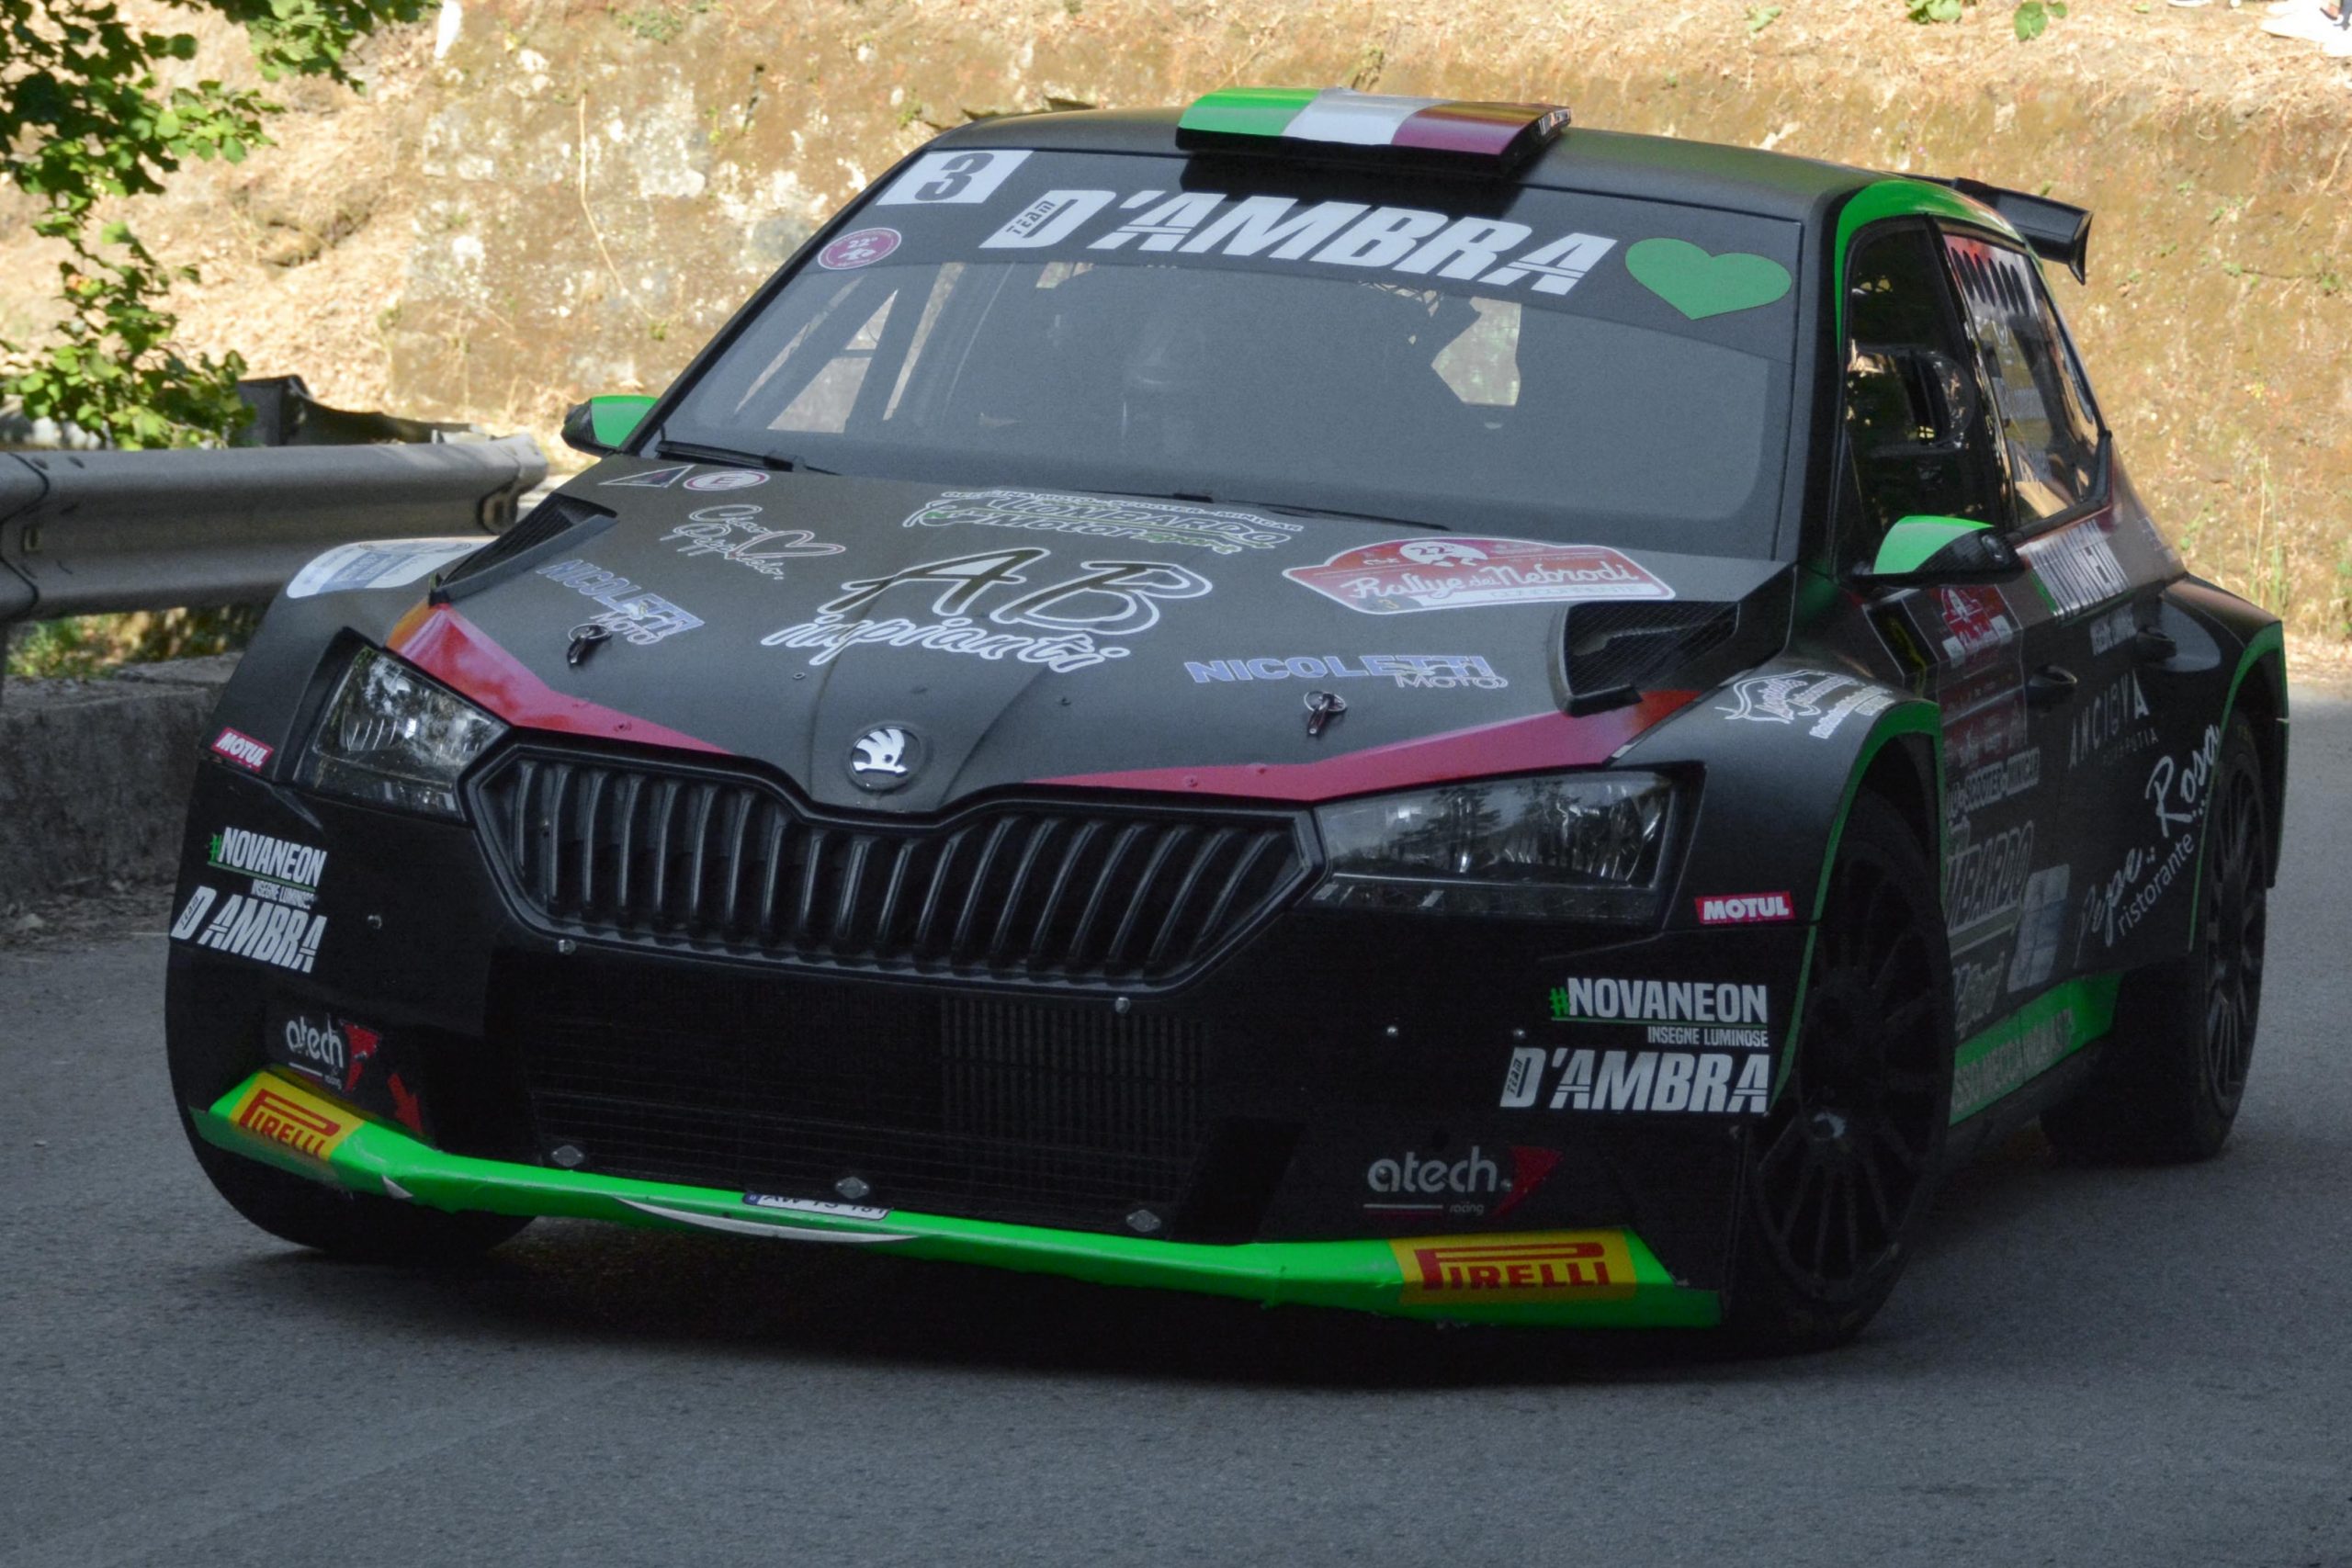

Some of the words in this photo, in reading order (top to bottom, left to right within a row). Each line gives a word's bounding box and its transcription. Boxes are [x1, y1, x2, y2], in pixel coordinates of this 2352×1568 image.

[914, 152, 995, 201] 3
[978, 189, 1618, 295] D'AMBRA
[1005, 200, 1057, 238] TEAM
[987, 496, 1292, 545] LOMBARDO
[1340, 573, 1466, 599] Rallye
[1469, 576, 1500, 587] dei
[1479, 561, 1639, 585] Nebrodi
[1184, 655, 1496, 683] NICOLETTI
[217, 732, 268, 768] MOTUL
[2145, 724, 2220, 838] Rosa
[1703, 896, 1790, 919] MOTUL
[2118, 833, 2195, 936] ristorante
[286, 1014, 344, 1068] atech
[1647, 1026, 1700, 1044] INSEGNE
[1703, 1028, 1769, 1047] LUMINOSE
[1499, 1046, 1770, 1112] D'AMBRA
[239, 1088, 341, 1156] PIRELLI
[1367, 1145, 1498, 1193] atech
[1449, 1201, 1484, 1216] racing
[1414, 1242, 1610, 1291] PIRELLI
